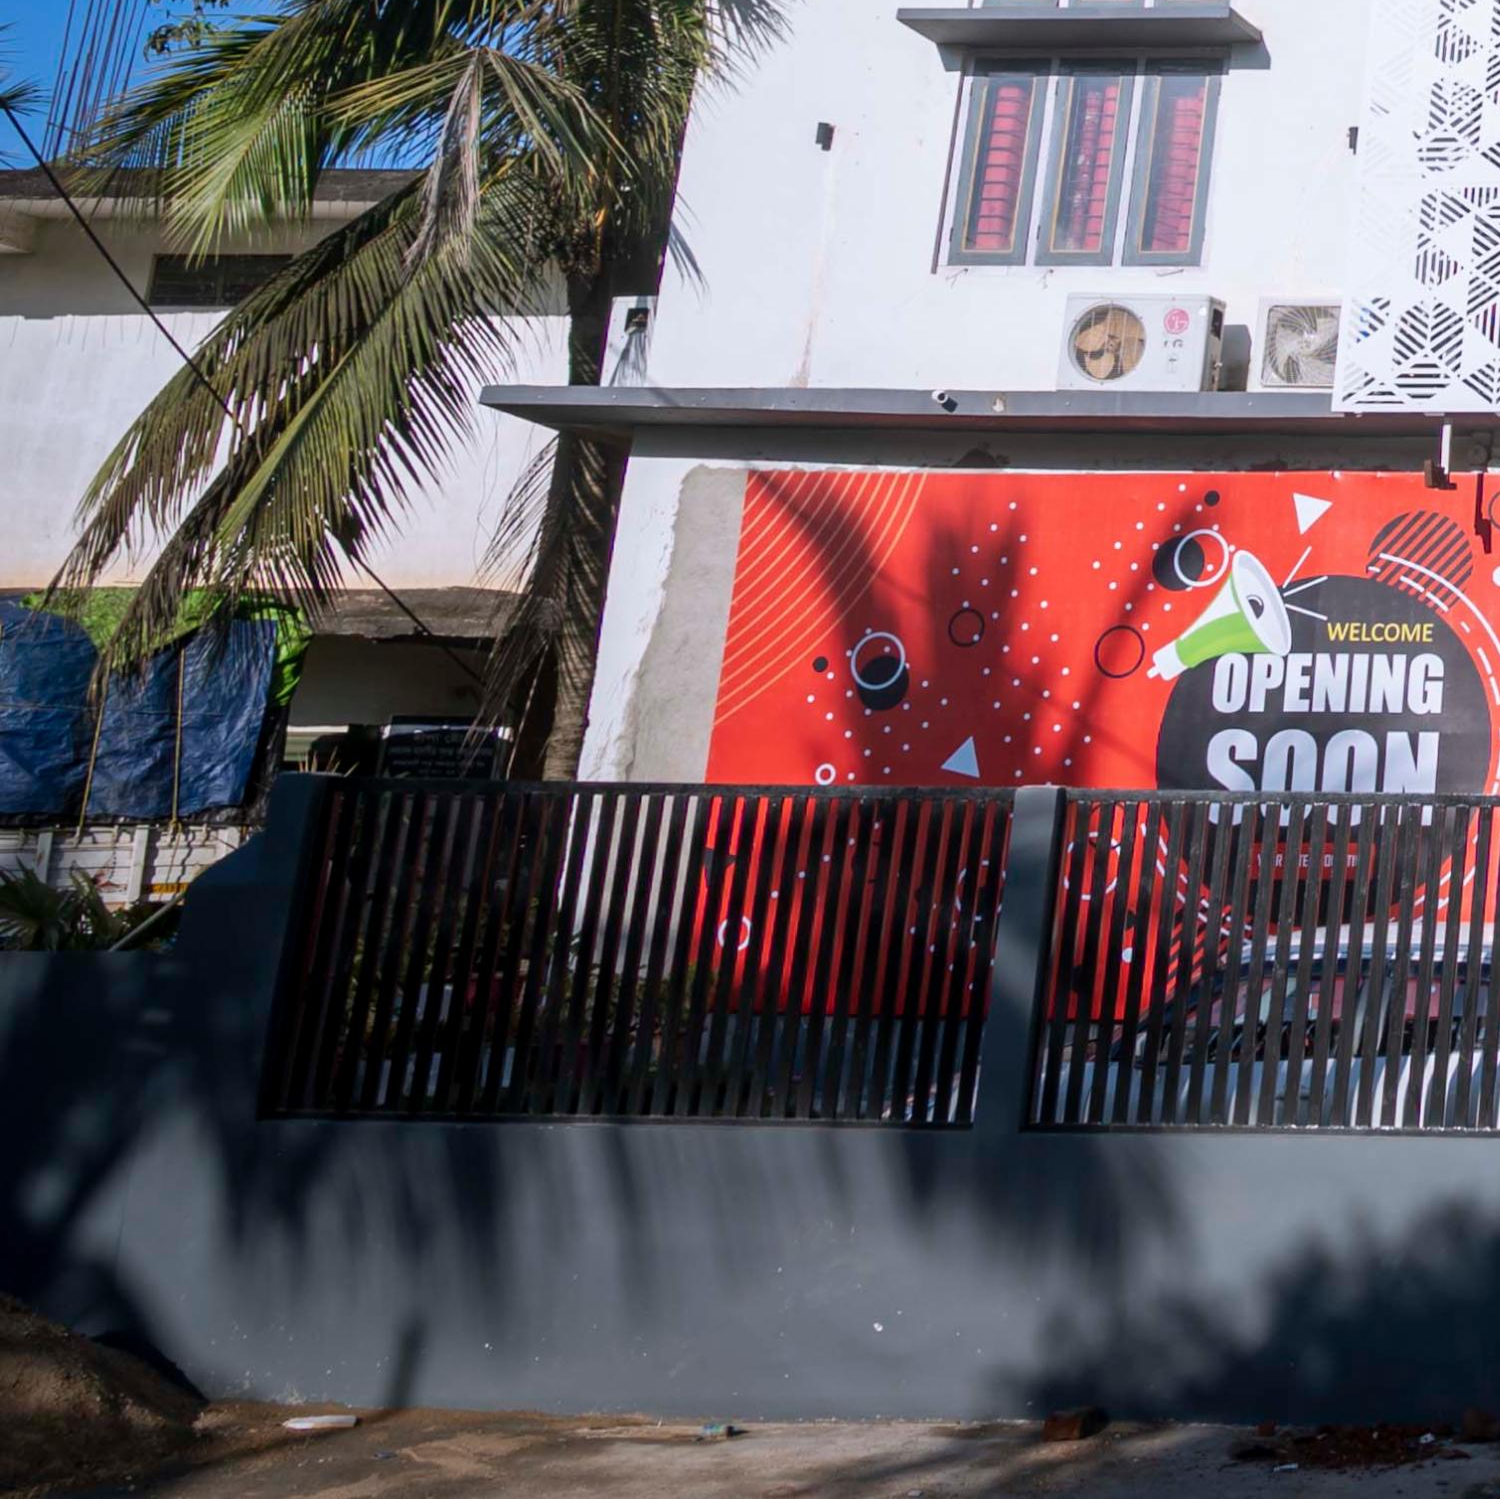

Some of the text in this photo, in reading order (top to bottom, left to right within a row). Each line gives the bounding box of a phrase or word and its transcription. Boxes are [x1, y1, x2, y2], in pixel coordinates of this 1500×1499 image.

[1327, 622, 1434, 642] WELCOME
[1212, 653, 1445, 715] OPENING
[1206, 728, 1440, 827] SOON
